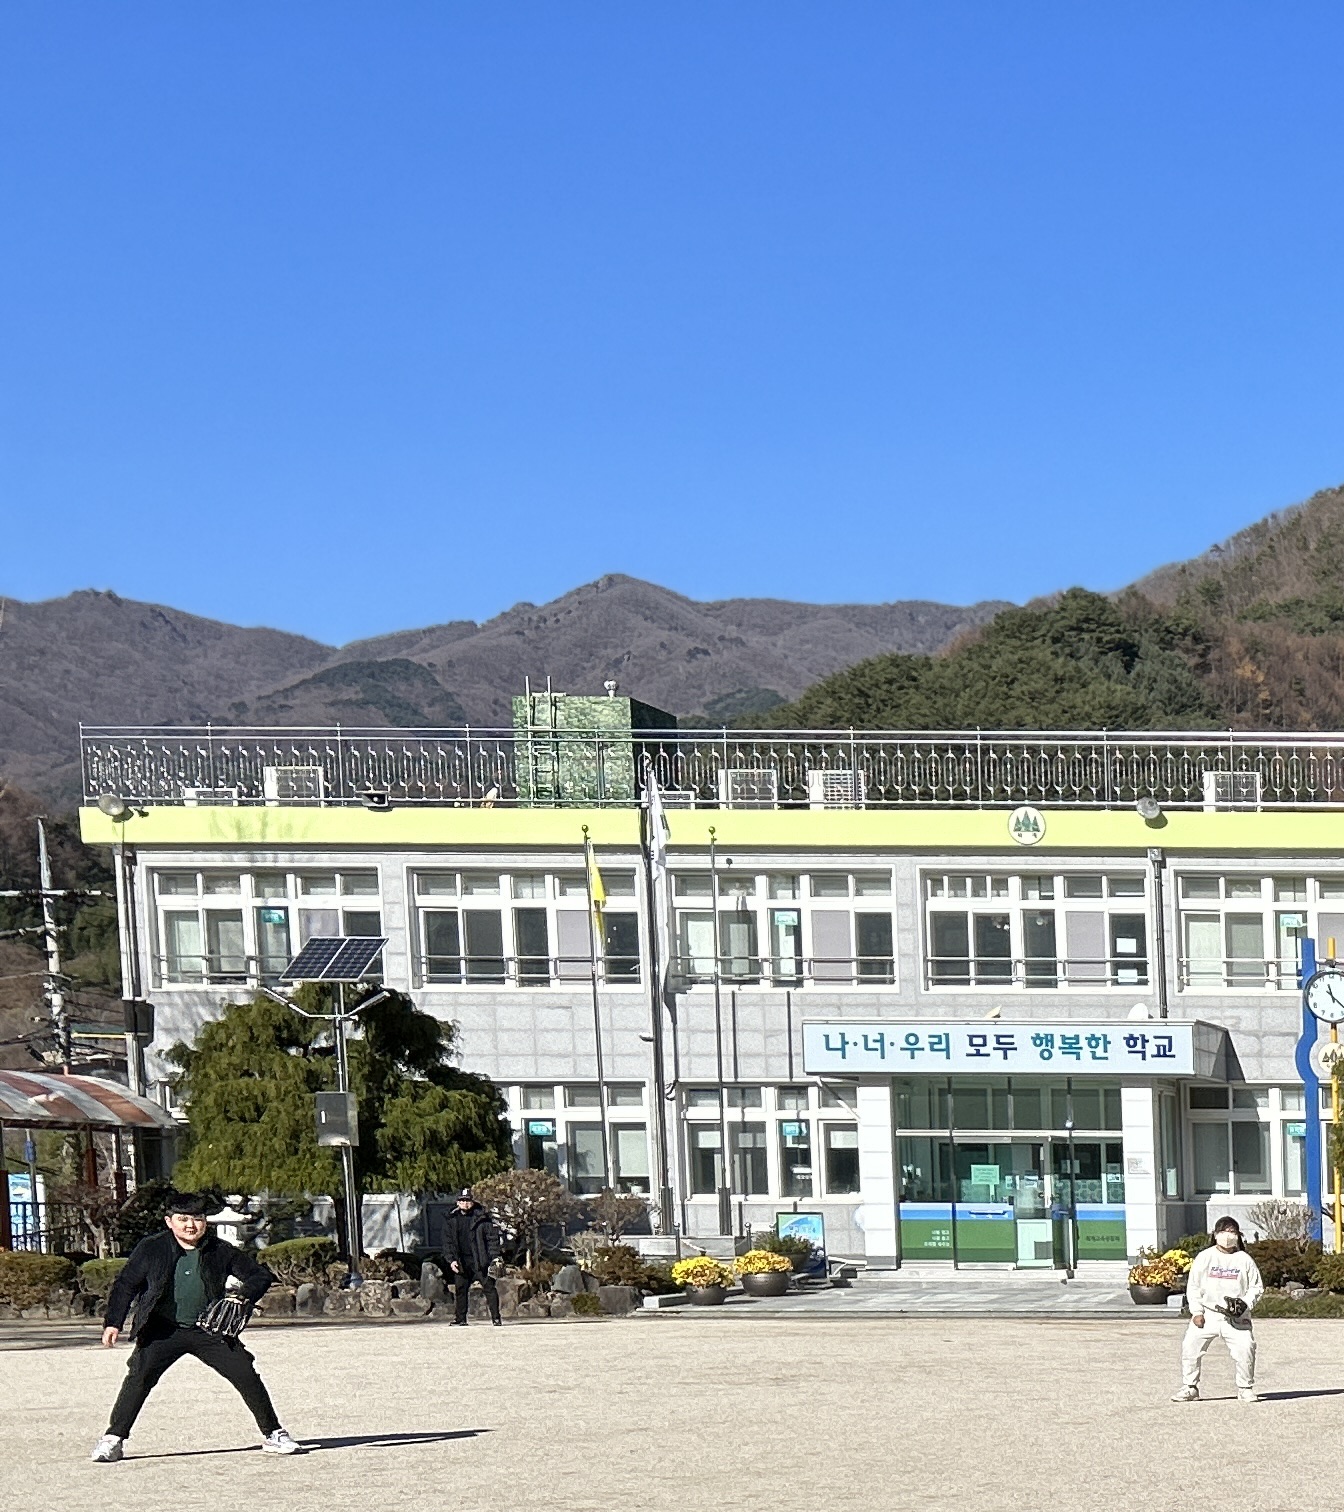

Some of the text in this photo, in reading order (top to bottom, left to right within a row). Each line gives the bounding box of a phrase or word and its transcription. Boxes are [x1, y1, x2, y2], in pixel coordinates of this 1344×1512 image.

[965, 1034, 1018, 1060] 모두
[1031, 1033, 1112, 1061] 행복한
[1123, 1033, 1176, 1060] 학교
